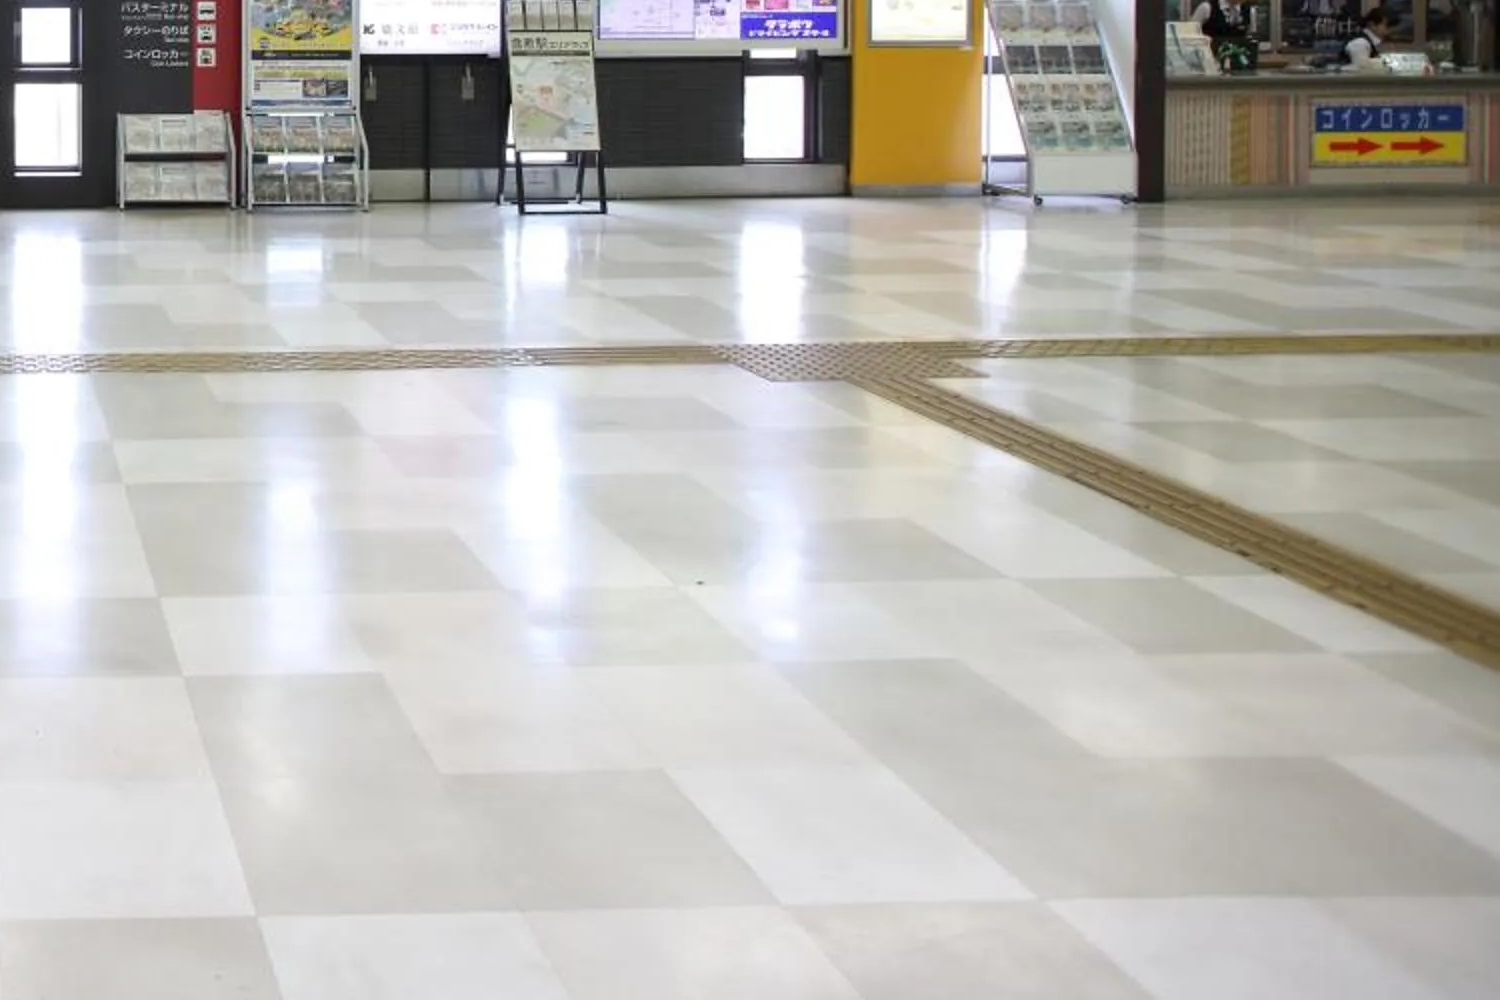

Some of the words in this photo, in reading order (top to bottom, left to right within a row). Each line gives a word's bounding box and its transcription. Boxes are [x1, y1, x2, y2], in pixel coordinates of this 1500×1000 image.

[1321, 108, 1449, 130] コインロッカー
